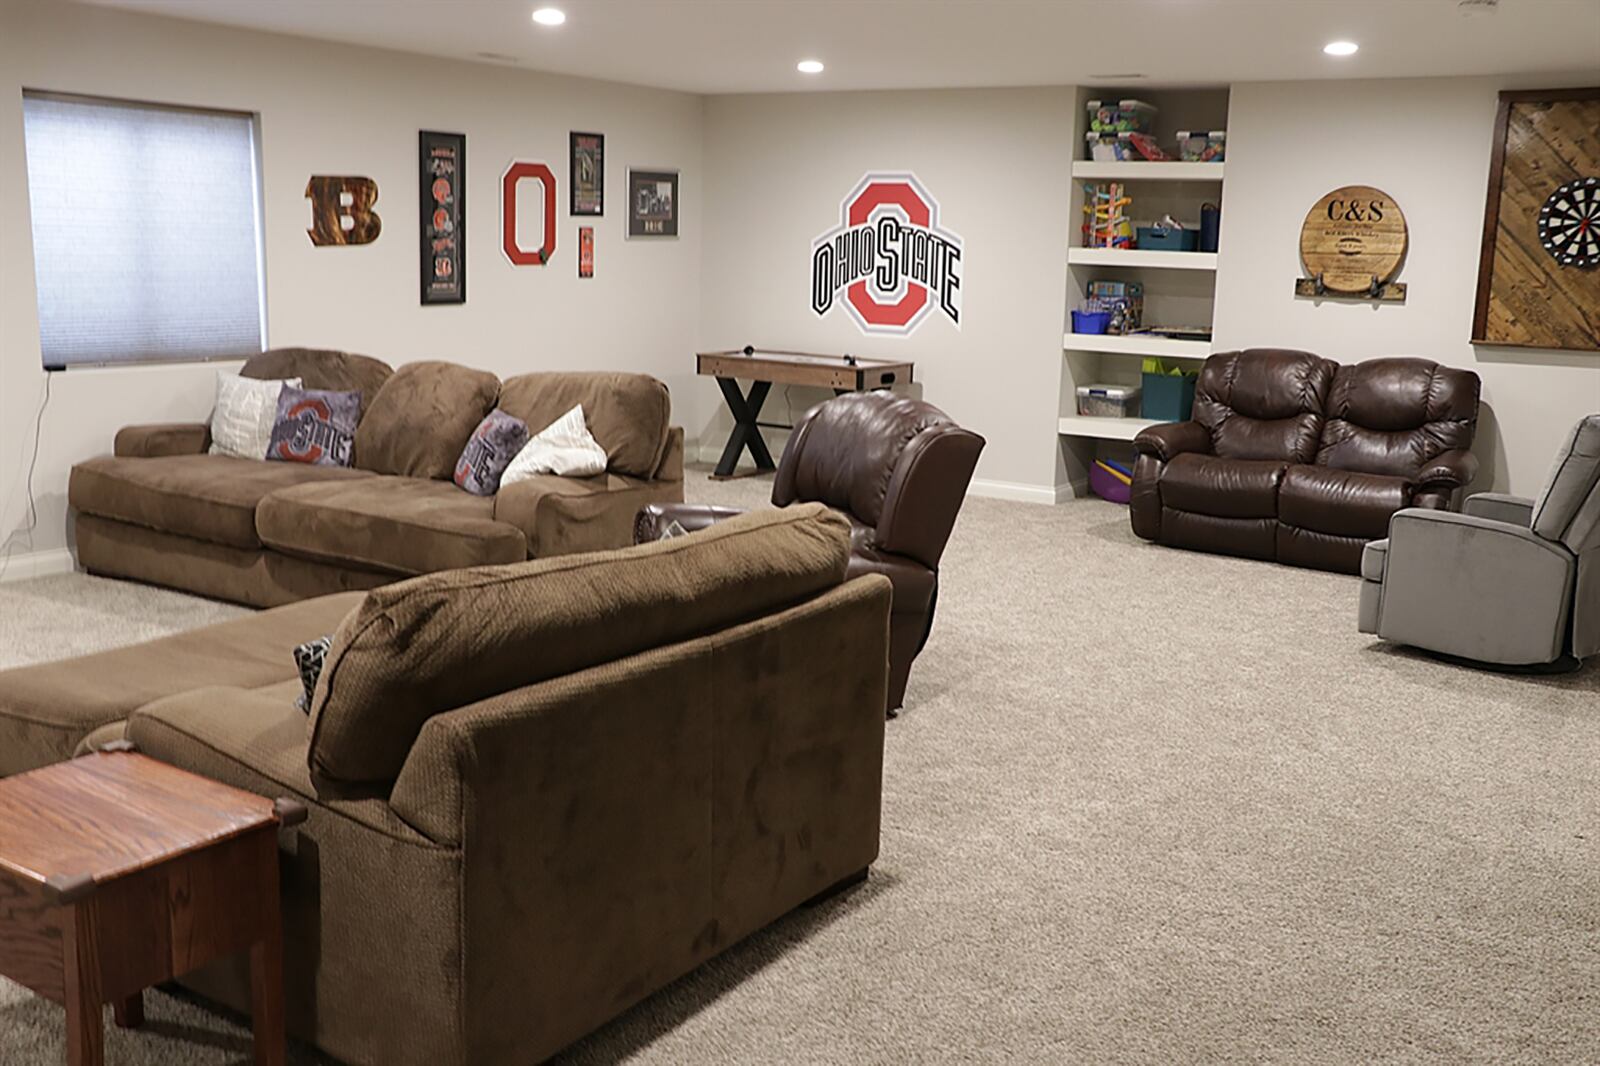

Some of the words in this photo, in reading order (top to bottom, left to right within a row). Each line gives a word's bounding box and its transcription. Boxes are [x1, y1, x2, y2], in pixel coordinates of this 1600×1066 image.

[305, 175, 381, 246] B
[501, 159, 557, 267] O
[1327, 199, 1384, 222] C&S
[812, 226, 876, 315] OHIO
[876, 217, 962, 324] STATE
